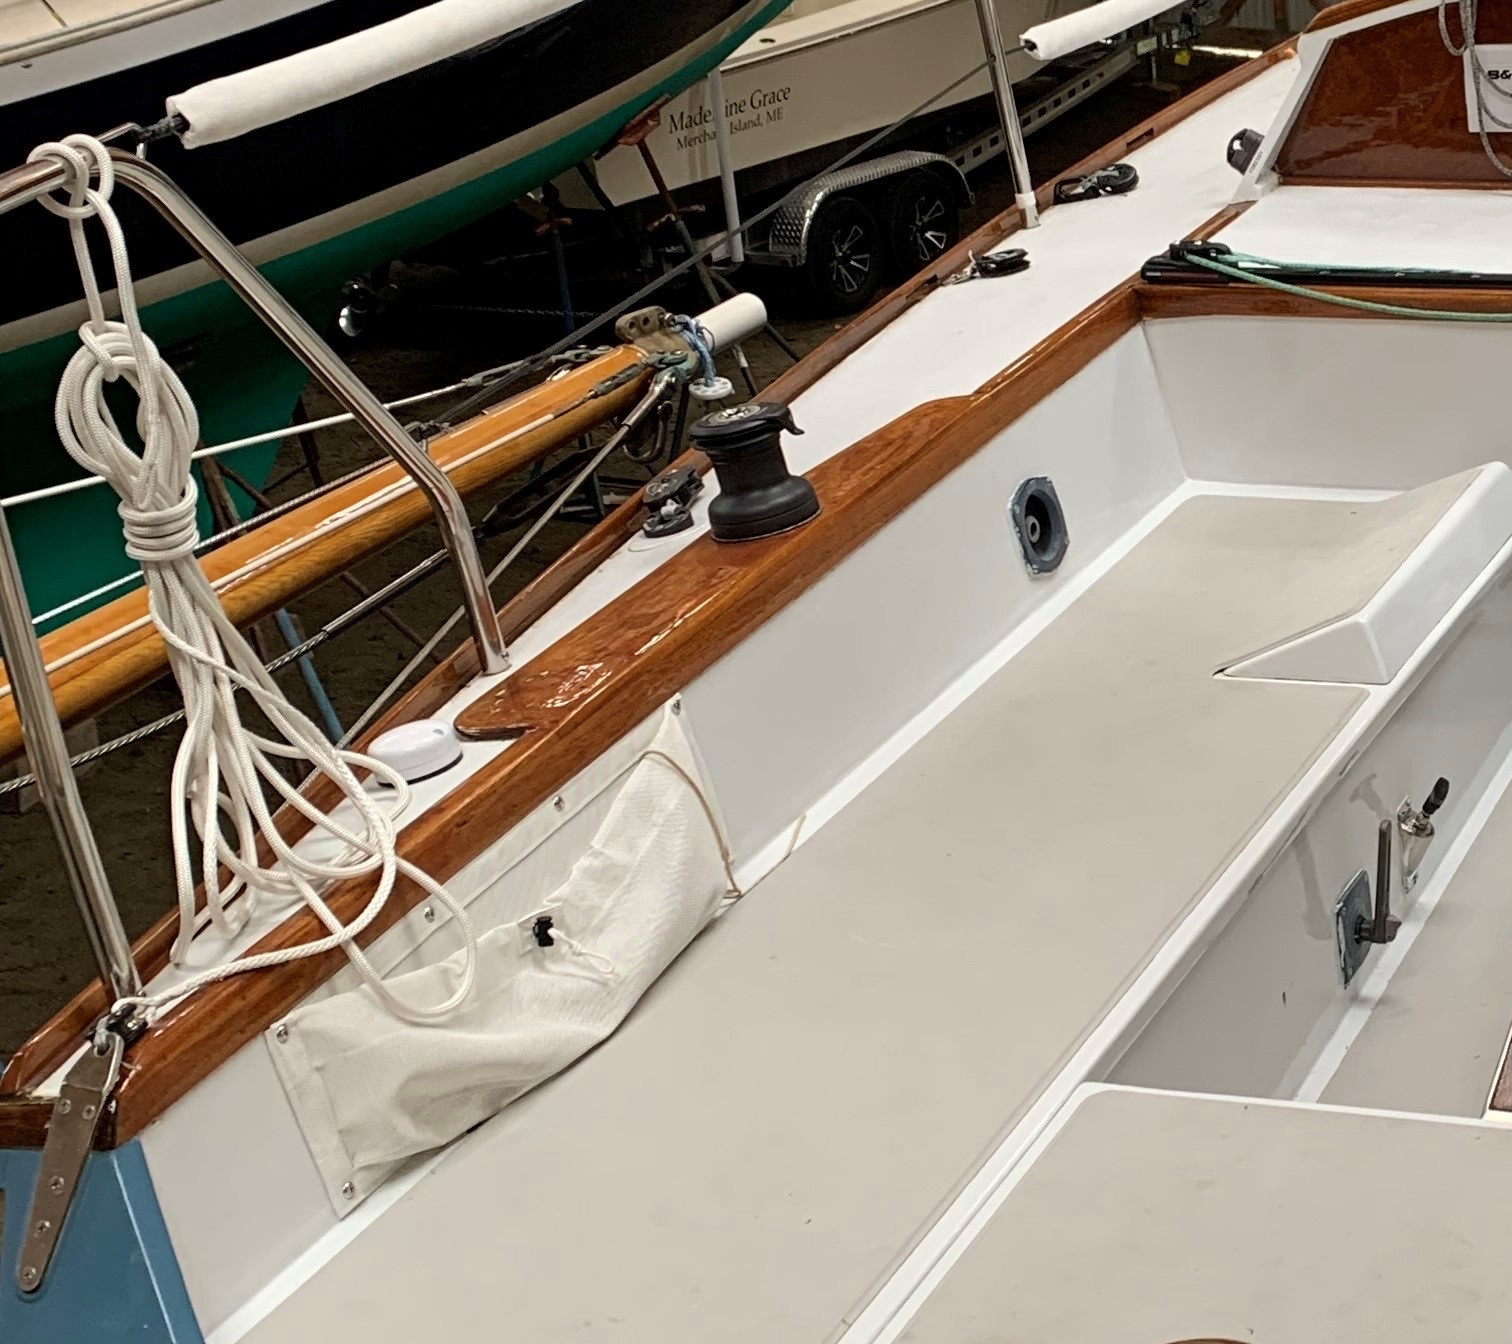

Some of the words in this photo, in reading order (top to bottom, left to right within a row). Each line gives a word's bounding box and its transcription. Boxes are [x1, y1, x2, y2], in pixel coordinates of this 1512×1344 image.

[668, 98, 746, 135] Madeine
[750, 87, 791, 110] Grace
[729, 113, 763, 135] Island,
[765, 107, 785, 125] ME
